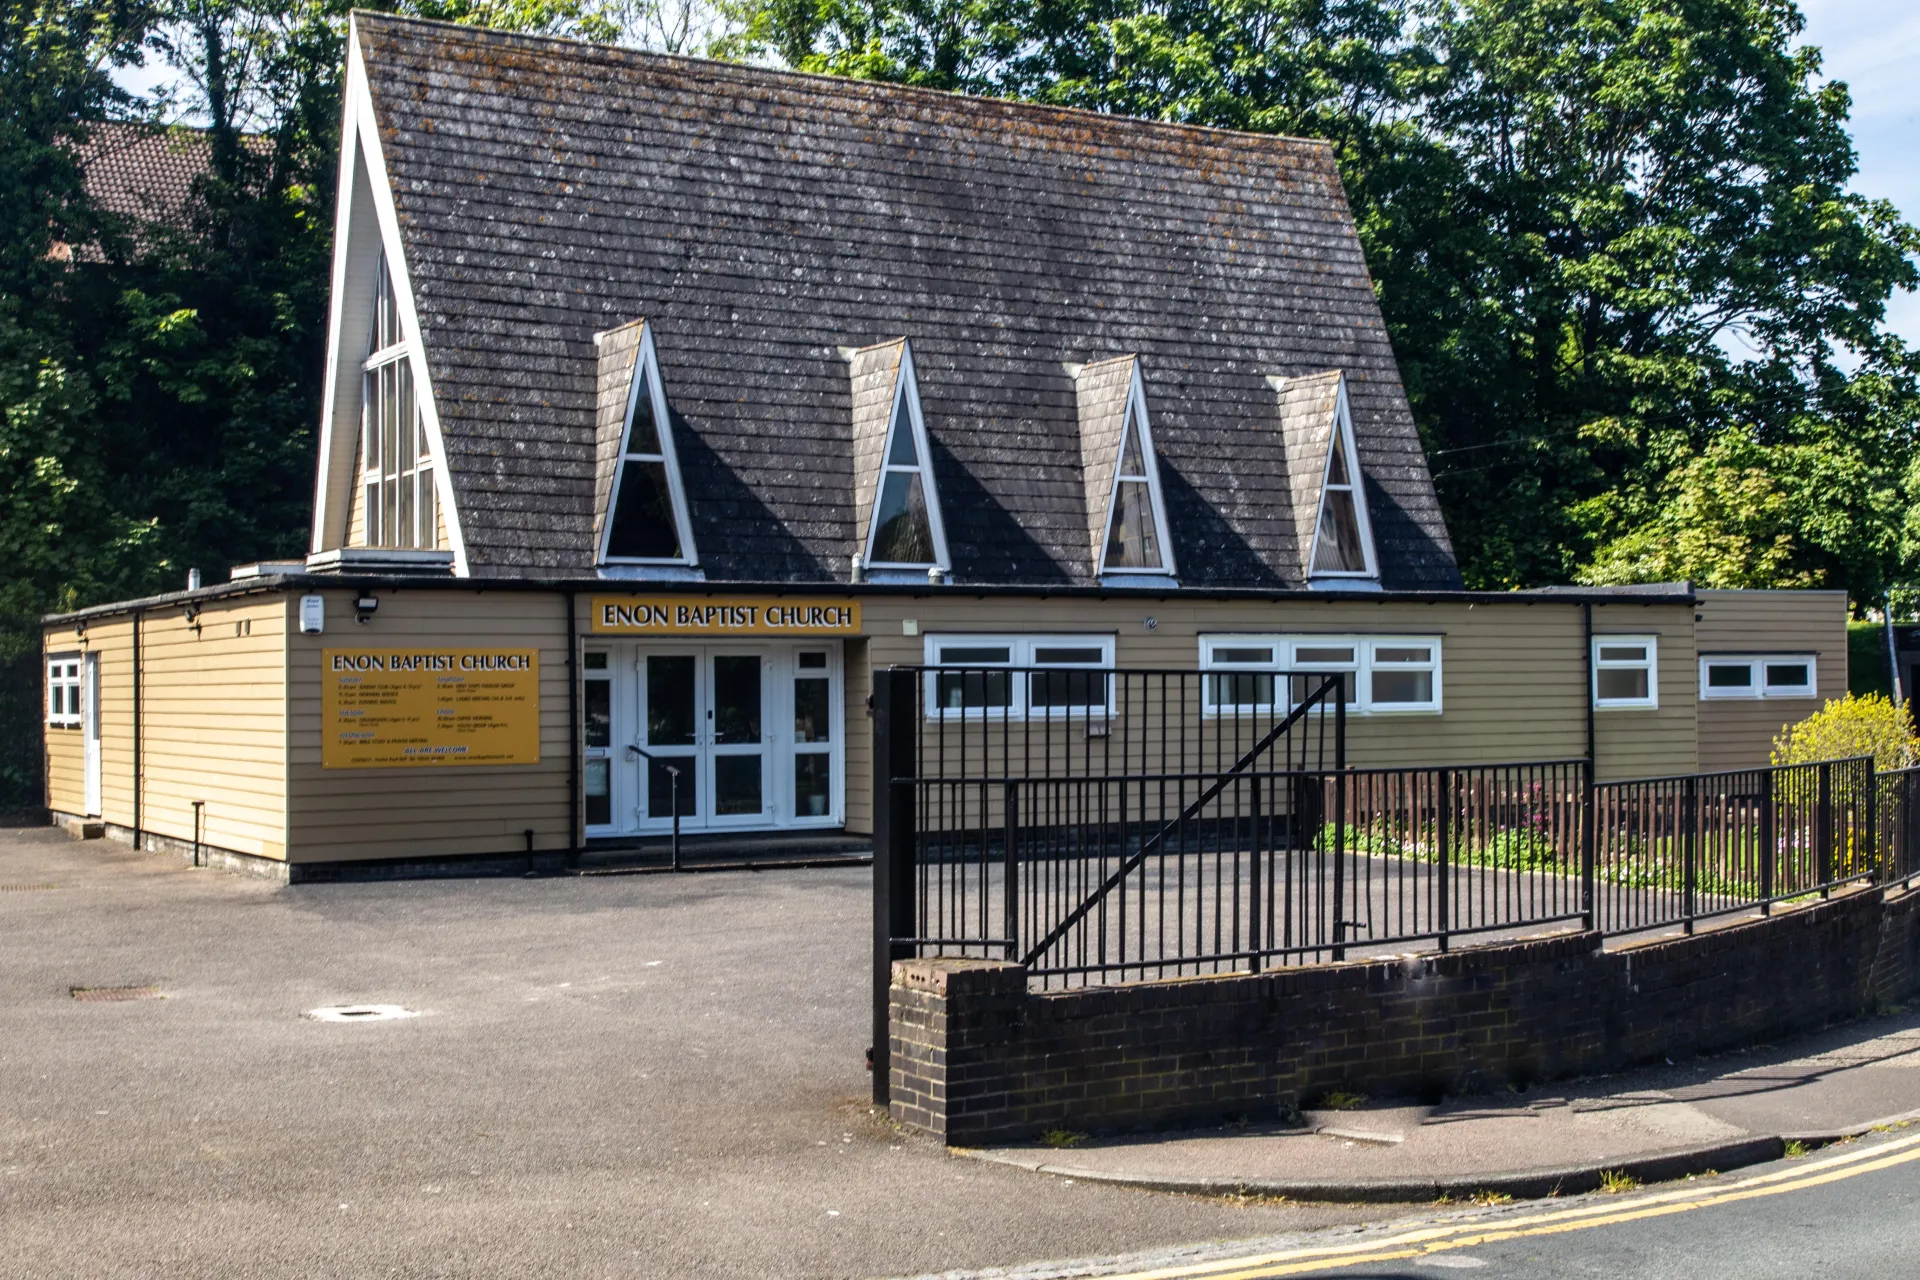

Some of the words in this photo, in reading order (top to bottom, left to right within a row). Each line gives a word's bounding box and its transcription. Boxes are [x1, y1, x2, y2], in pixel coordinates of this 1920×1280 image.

[602, 604, 668, 627] ENON
[675, 604, 759, 627] BAPTIST
[764, 605, 852, 628] CHURCH
[331, 654, 384, 672] ENON
[389, 654, 456, 672] BAPTIST
[459, 654, 530, 672] CHURCH
[434, 745, 469, 754] WELCOME
